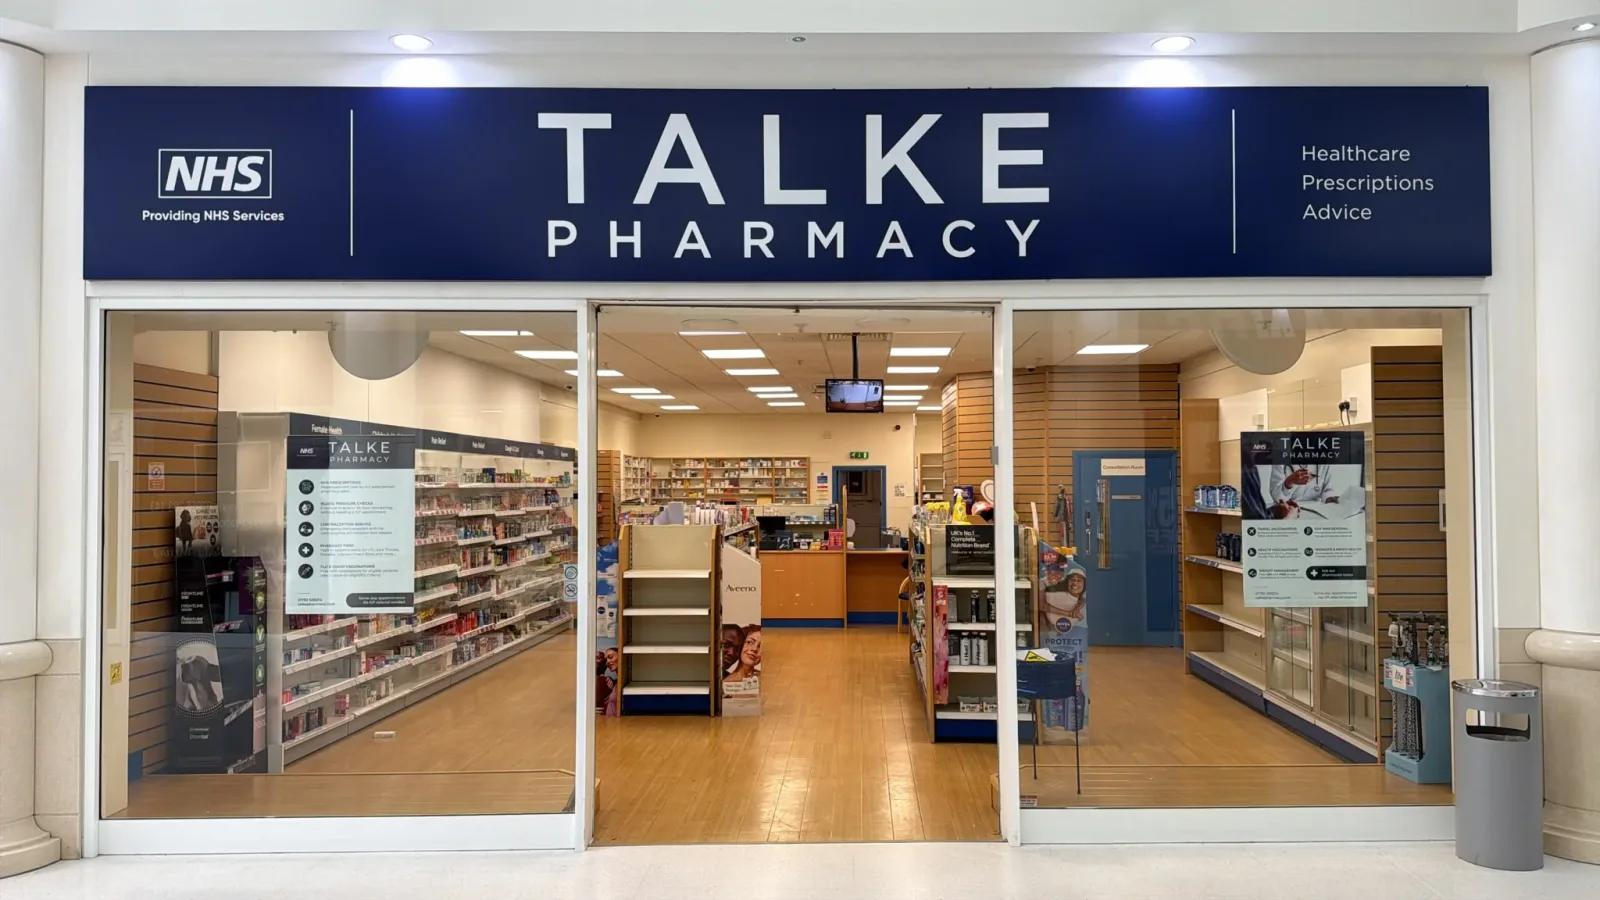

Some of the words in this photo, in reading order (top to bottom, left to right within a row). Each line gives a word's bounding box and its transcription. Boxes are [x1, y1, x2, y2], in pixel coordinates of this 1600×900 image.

[537, 112, 1050, 205] TALKE
[1301, 145, 1410, 162] Healthcare
[165, 155, 264, 192] NHS
[1302, 174, 1434, 193] Prescriptions
[142, 209, 200, 224] Providing
[204, 209, 230, 222] NHS
[232, 209, 284, 222] Services
[1302, 203, 1372, 220] Advice
[547, 219, 1040, 259] PHARMACY
[311, 423, 328, 434] Female
[327, 441, 390, 454] TALKE
[1281, 437, 1340, 449] TALKE
[1282, 451, 1340, 459] PHARMACY
[725, 584, 757, 592] Aveeno
[1045, 638, 1083, 646] PROTECT
